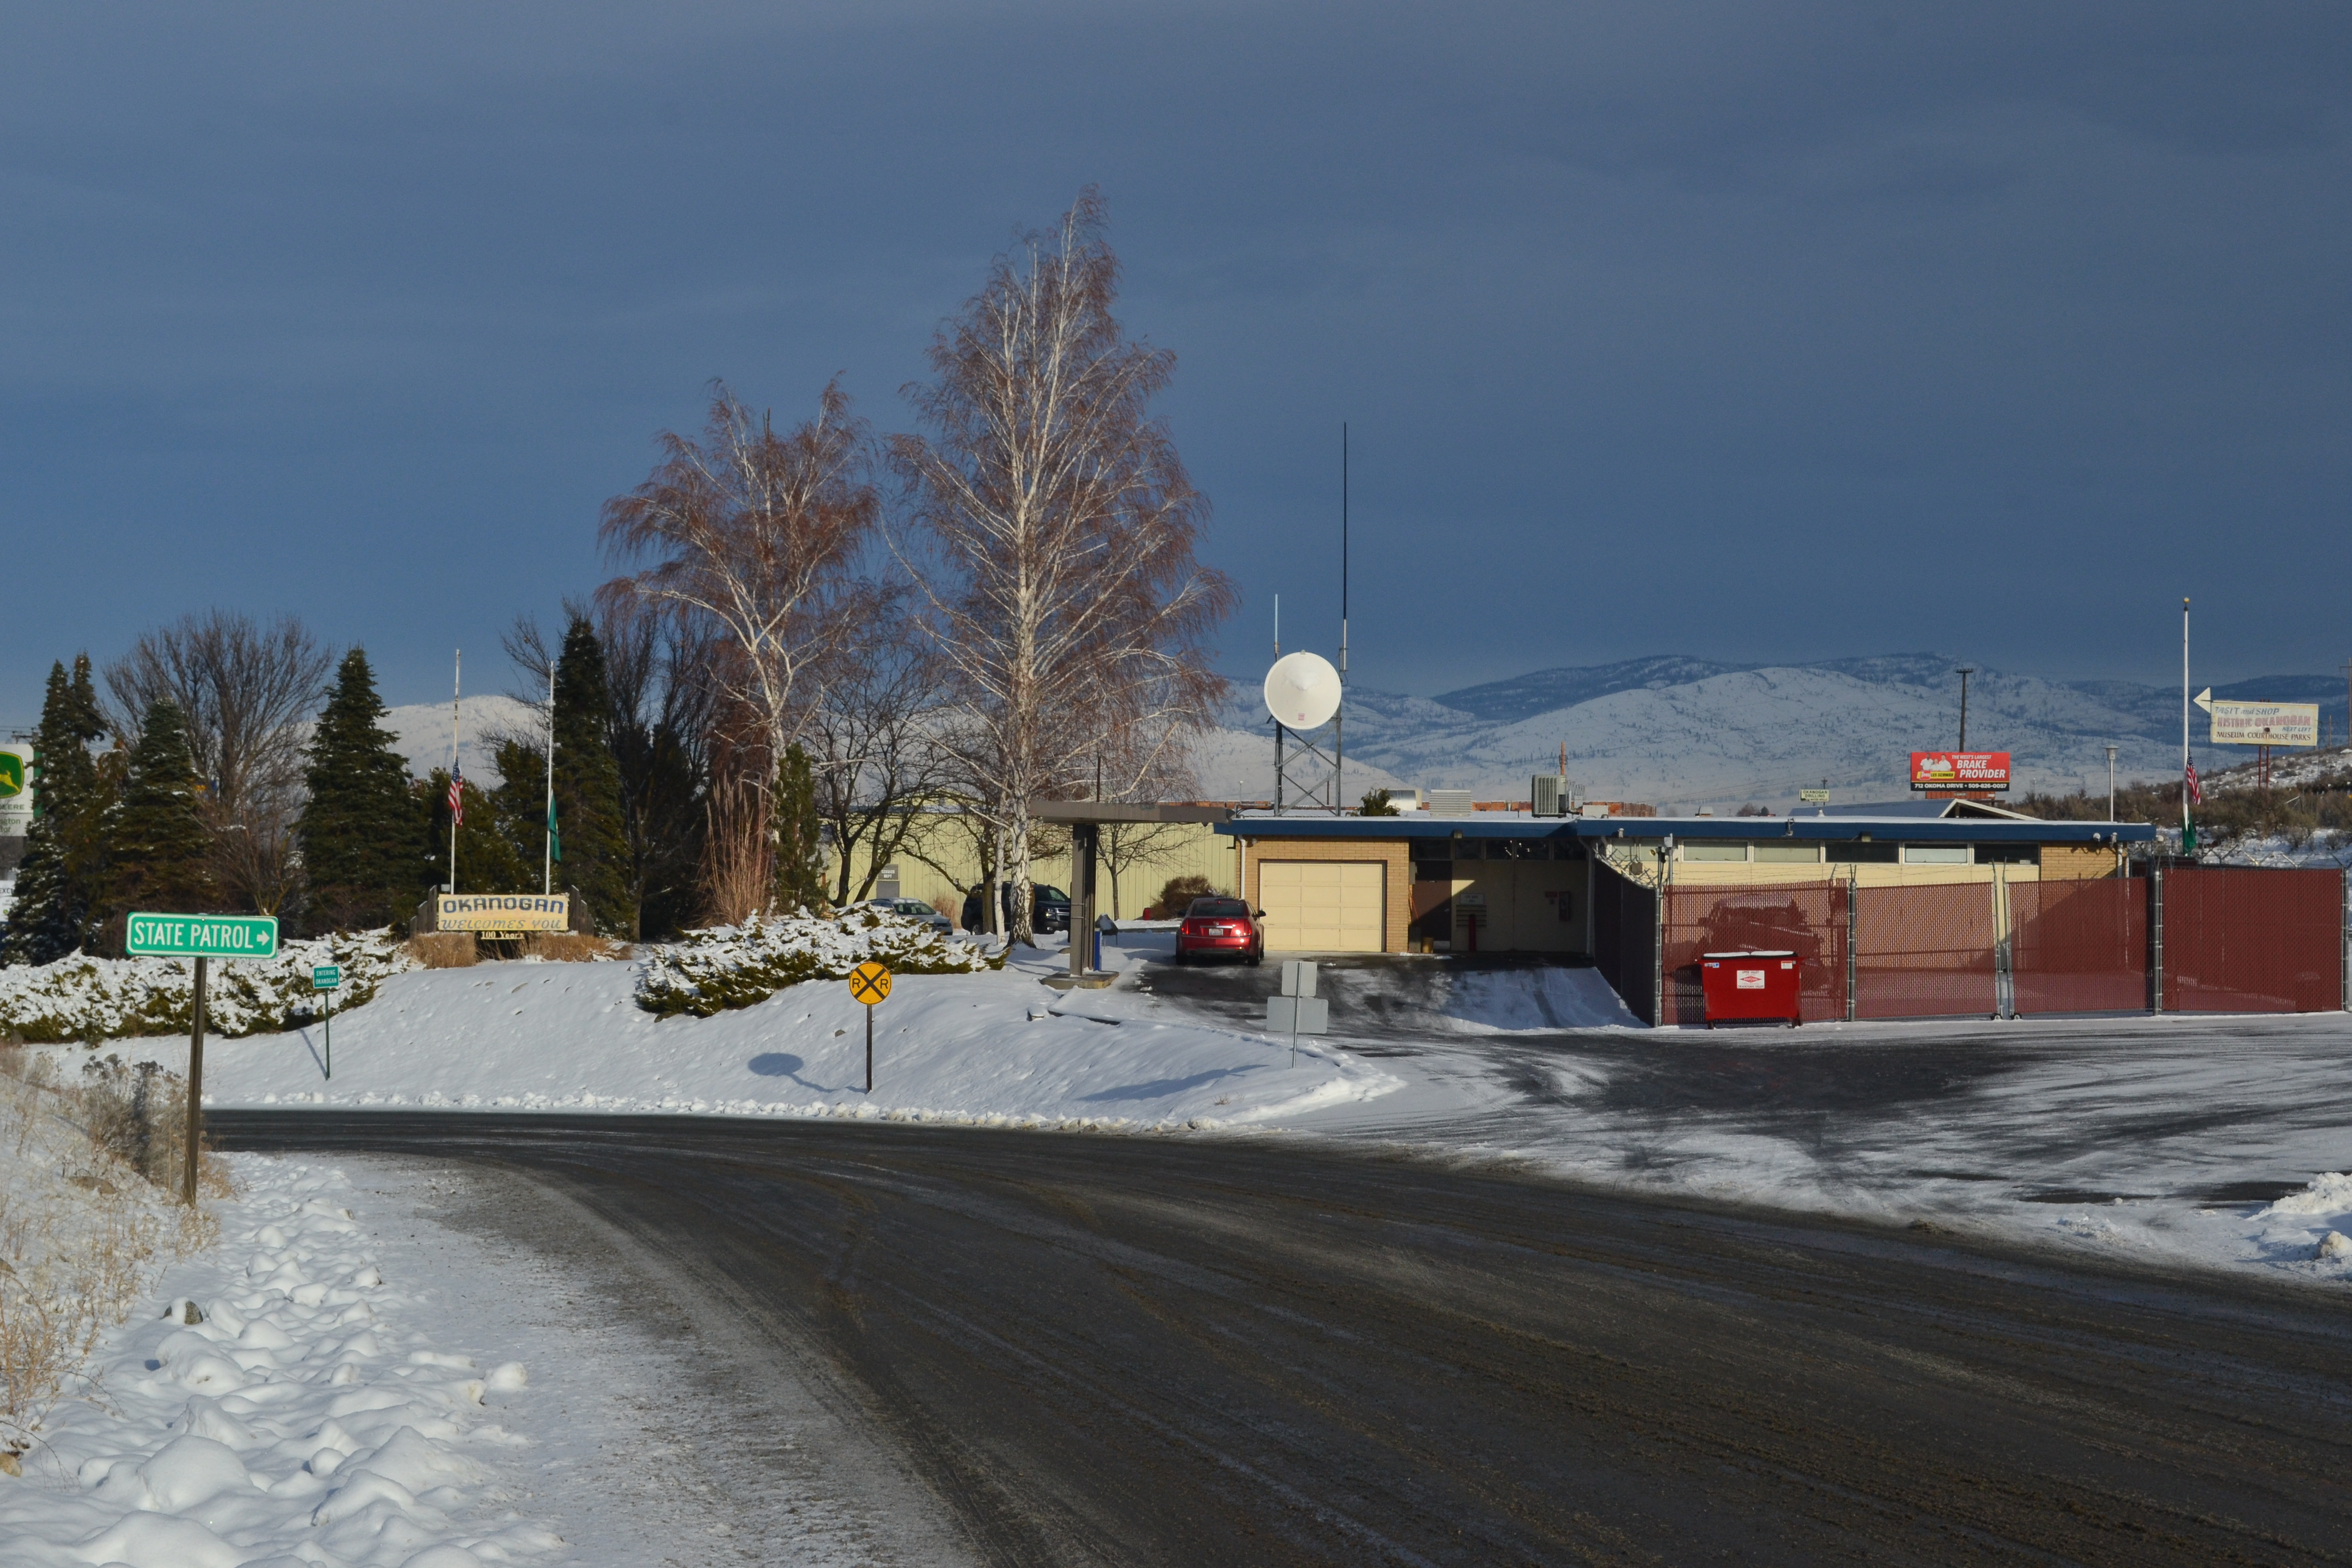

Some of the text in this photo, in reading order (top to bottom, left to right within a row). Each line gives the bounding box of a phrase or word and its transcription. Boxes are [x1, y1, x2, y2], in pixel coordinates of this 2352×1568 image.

[2215, 706, 2240, 715] VISIT
[2217, 716, 2311, 727] HISTORIC OKANOGAN
[1956, 760, 1987, 769] BRAKE
[1959, 769, 2006, 778] PROVIDER
[443, 897, 564, 914] OKANOGAN
[441, 920, 561, 929] WELCOMES YOU
[134, 922, 254, 948] STATE PATROL
[852, 978, 888, 989] R R
